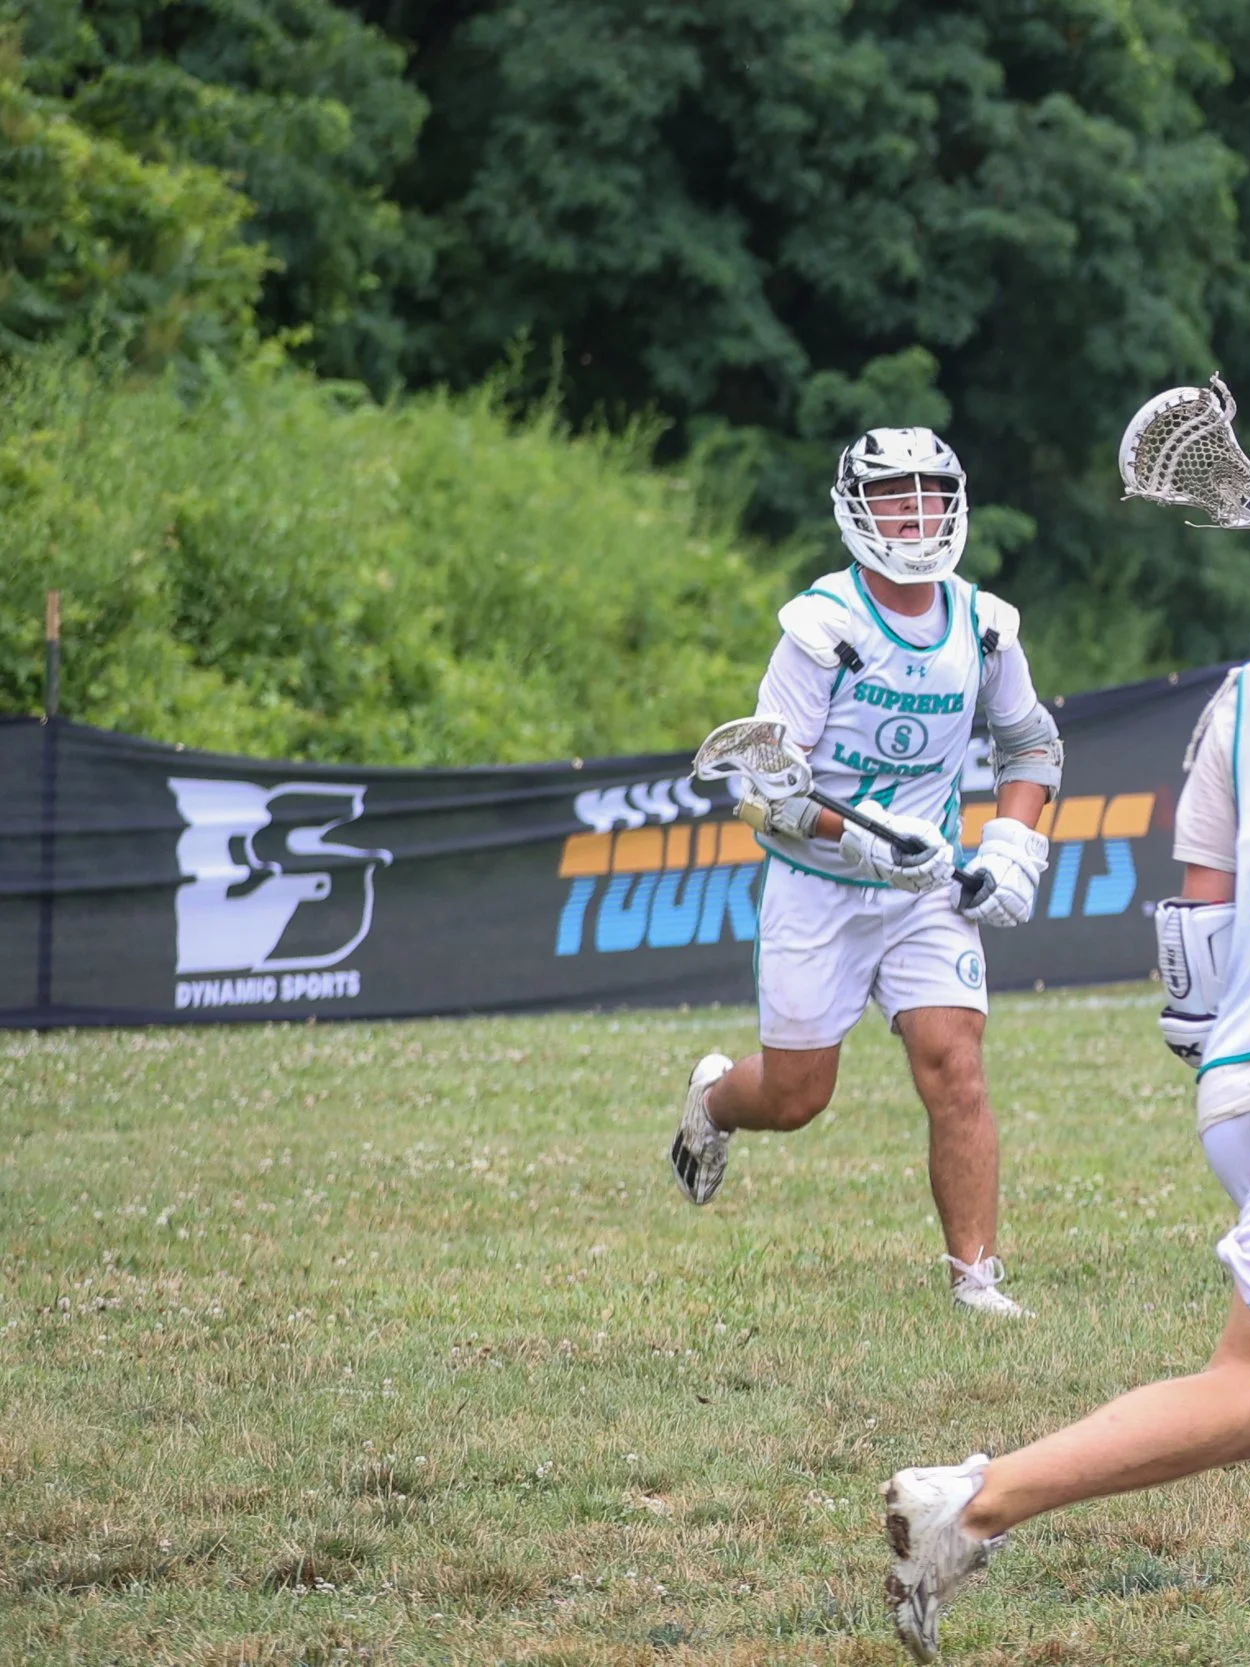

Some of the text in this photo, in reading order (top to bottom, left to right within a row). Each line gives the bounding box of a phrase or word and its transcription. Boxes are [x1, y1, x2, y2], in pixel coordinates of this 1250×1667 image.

[853, 681, 965, 715] SUPREME
[831, 741, 944, 778] LACROSS
[175, 969, 361, 1009] DYNAMIC SPORTS
